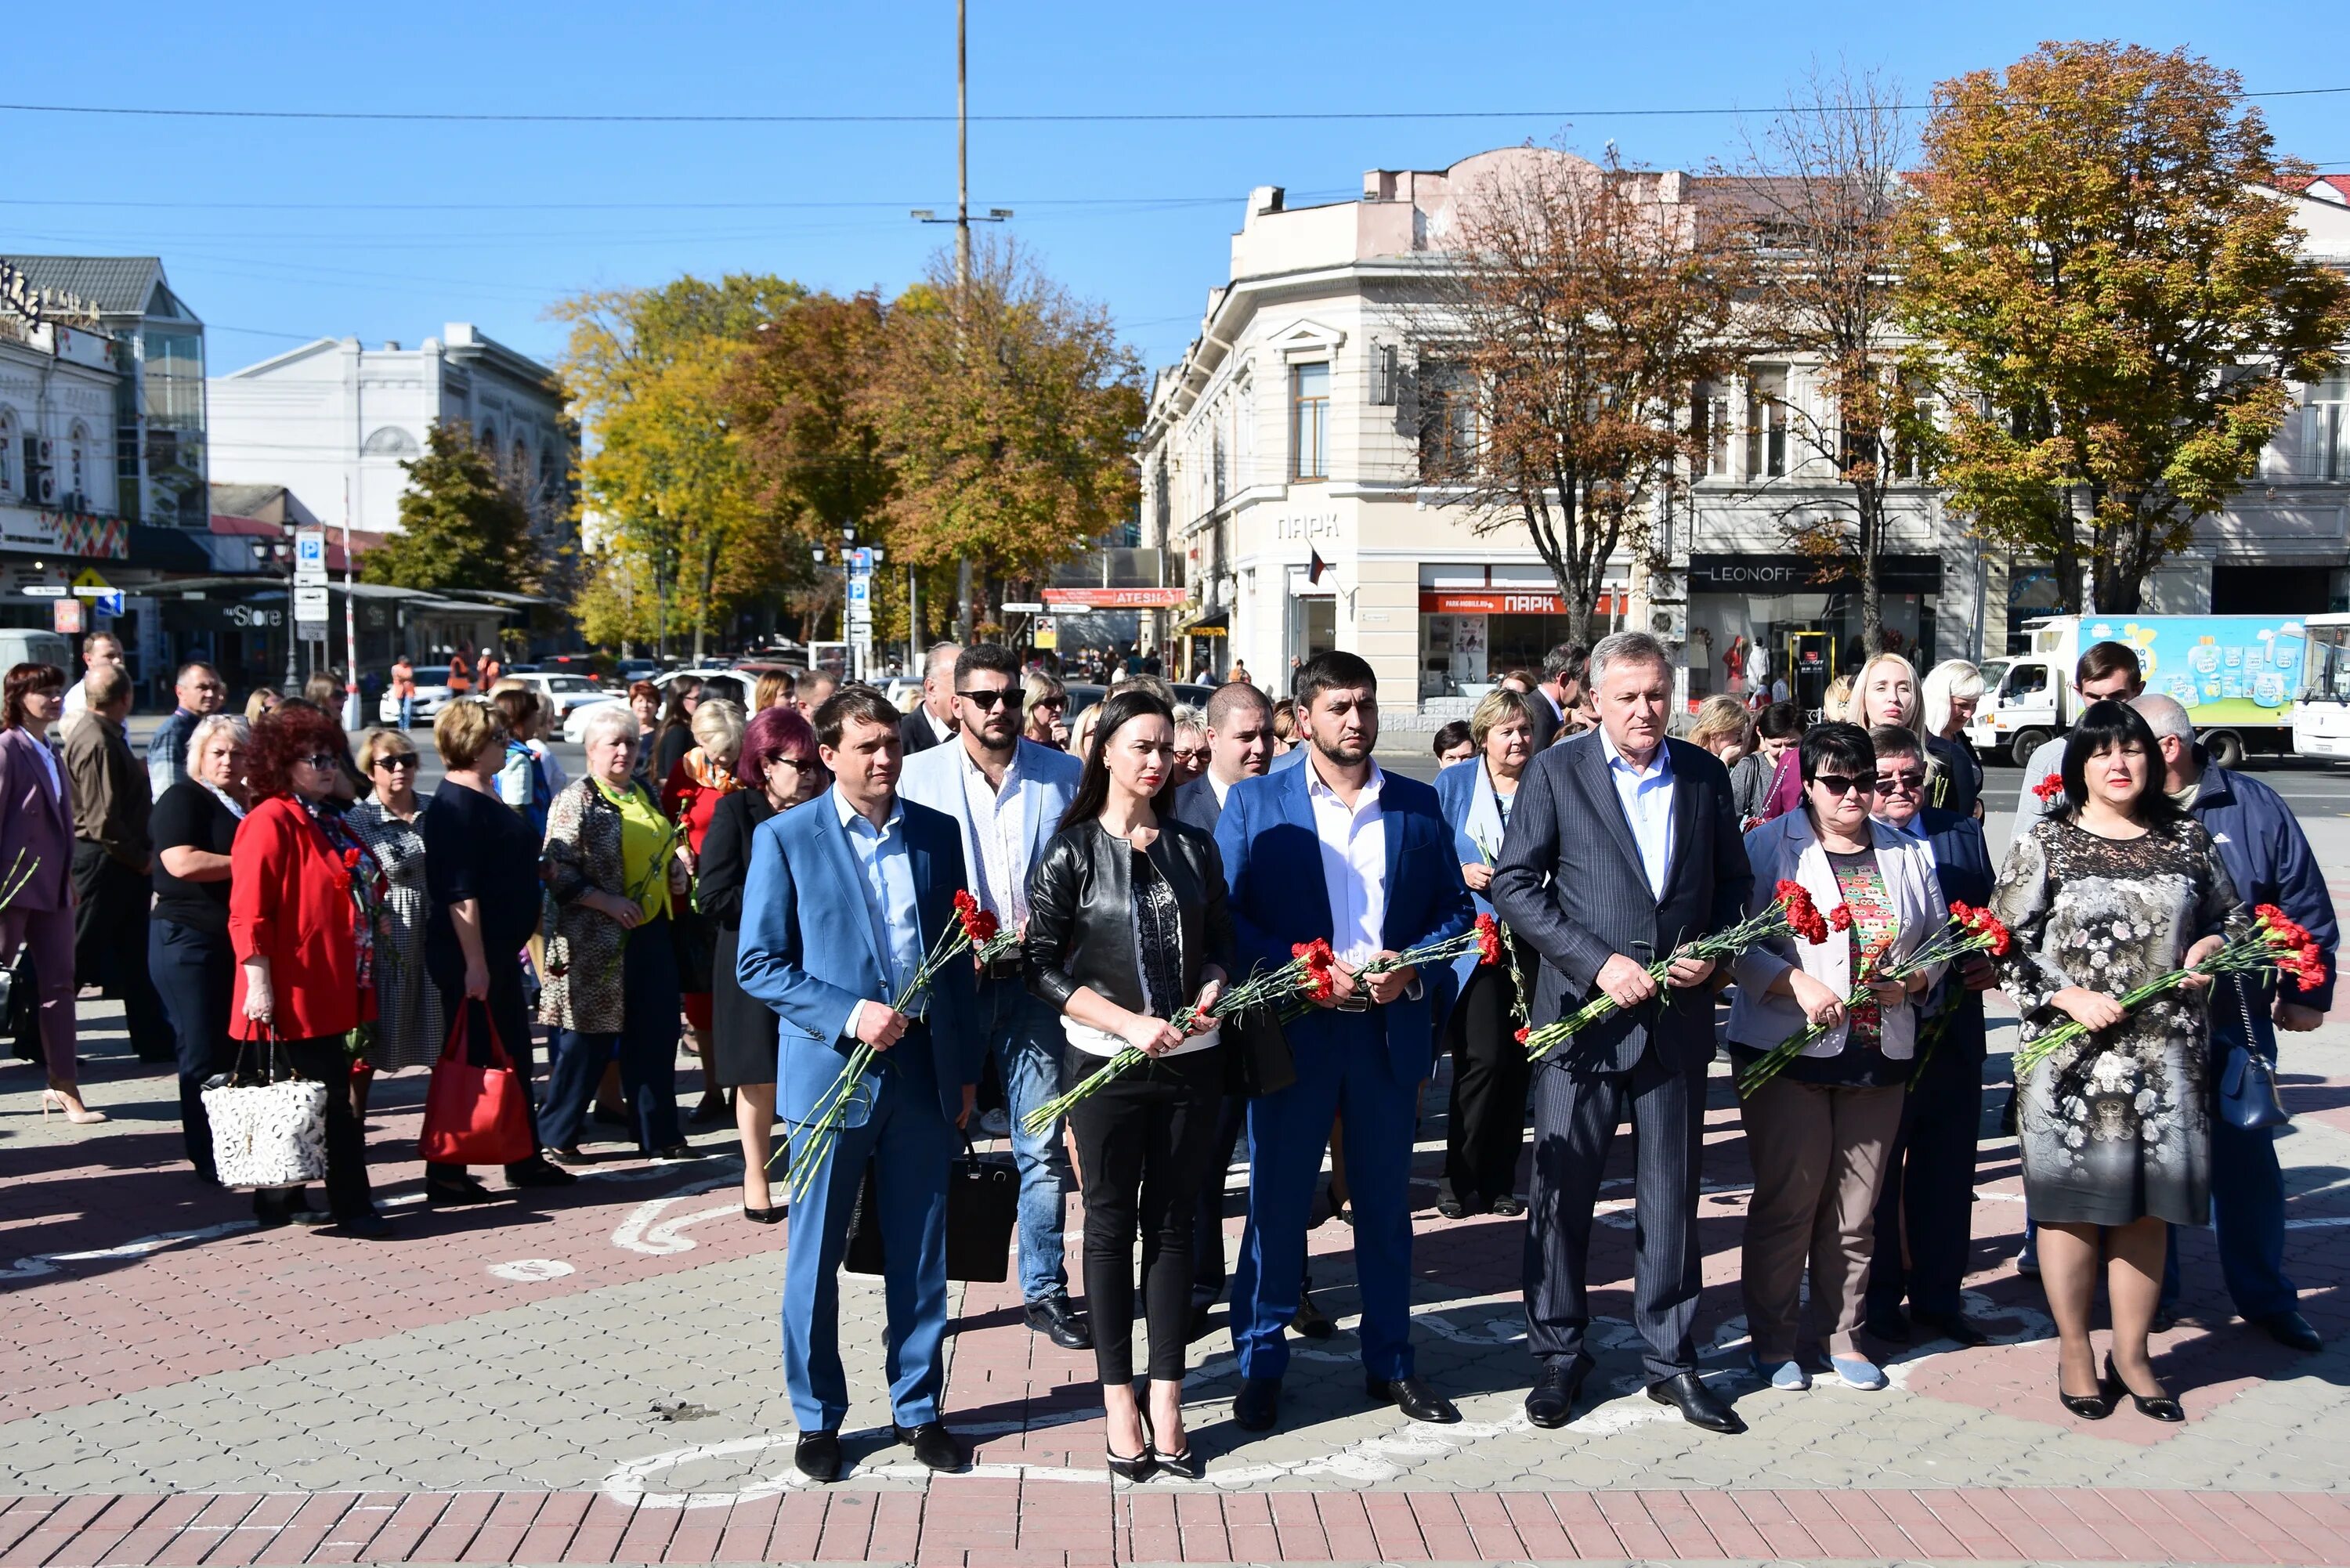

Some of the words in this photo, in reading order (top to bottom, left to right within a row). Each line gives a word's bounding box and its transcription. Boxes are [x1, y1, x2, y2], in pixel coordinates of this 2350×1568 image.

[1278, 513, 1339, 539] ПАРК
[1711, 567, 1796, 581] LEONOFF
[1116, 592, 1161, 603] ATESH
[1504, 595, 1555, 612] ПАРК
